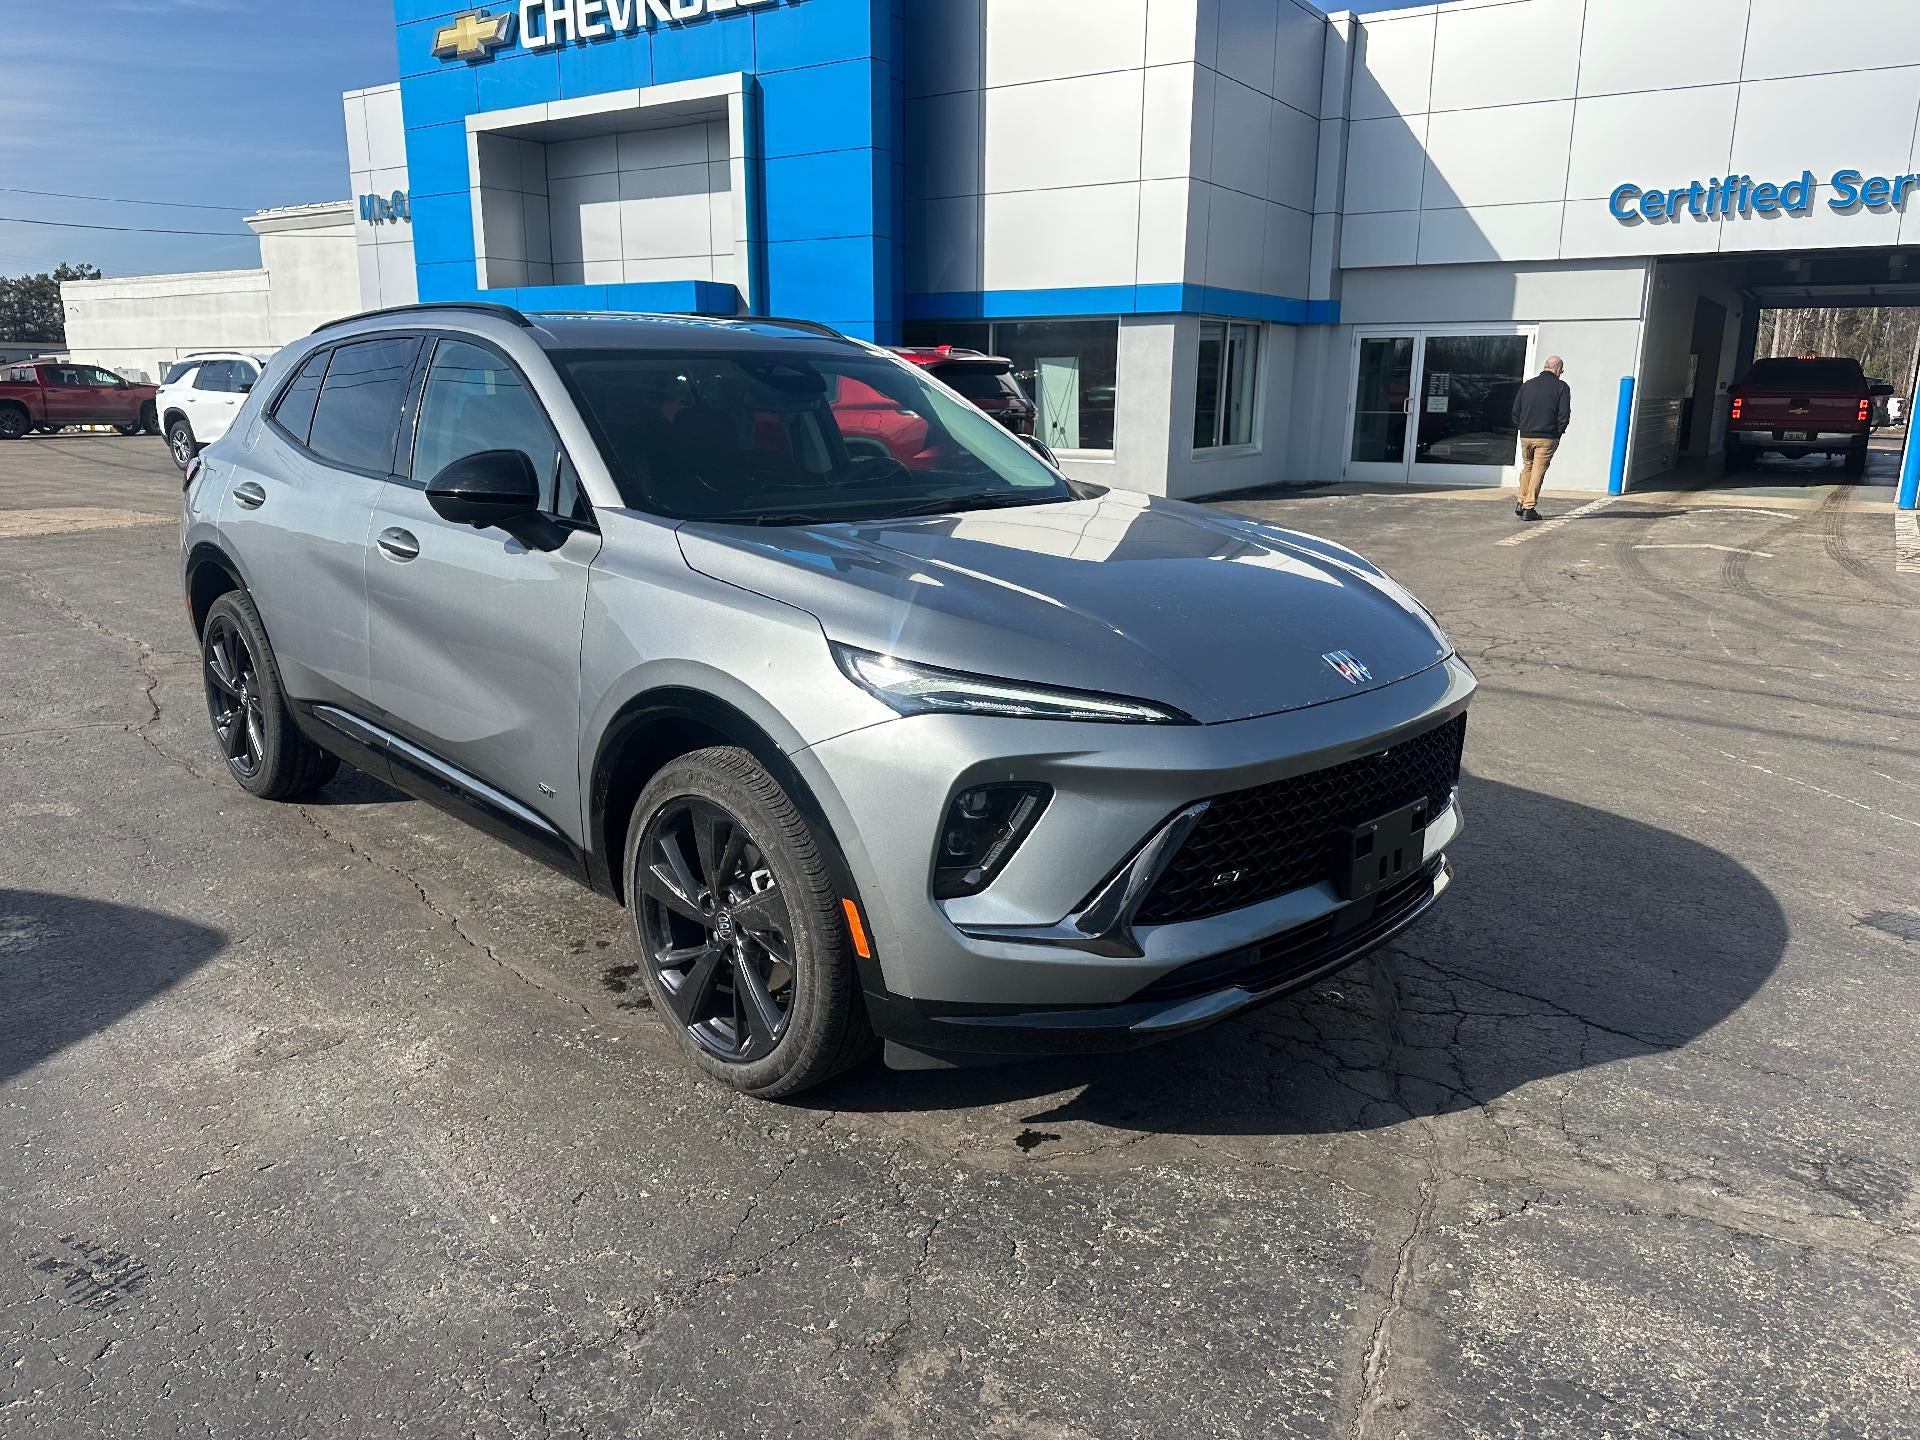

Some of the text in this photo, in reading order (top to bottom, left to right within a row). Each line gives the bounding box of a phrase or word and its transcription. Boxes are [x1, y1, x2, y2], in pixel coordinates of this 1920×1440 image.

[519, 0, 770, 48] CHEV
[1609, 169, 1920, 219] Certified Ser
